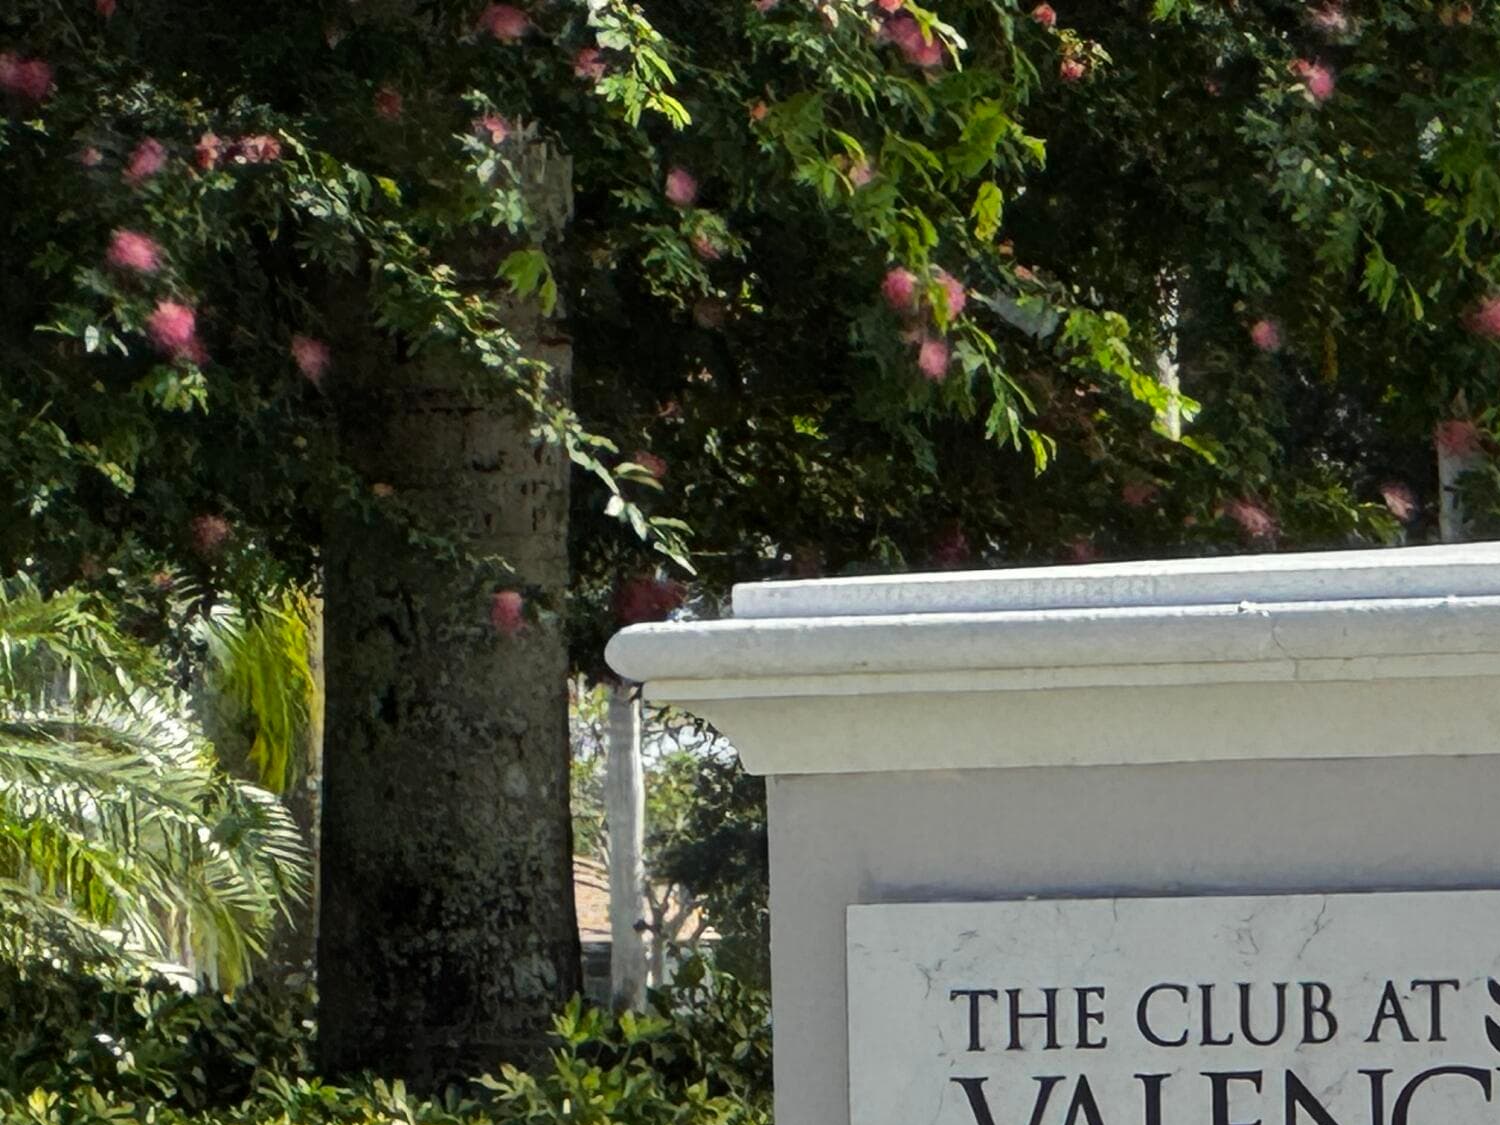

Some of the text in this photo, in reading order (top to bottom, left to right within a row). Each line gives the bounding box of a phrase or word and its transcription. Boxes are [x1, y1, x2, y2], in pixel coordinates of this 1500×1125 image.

[950, 979, 1460, 1052] THE CLUB AT
